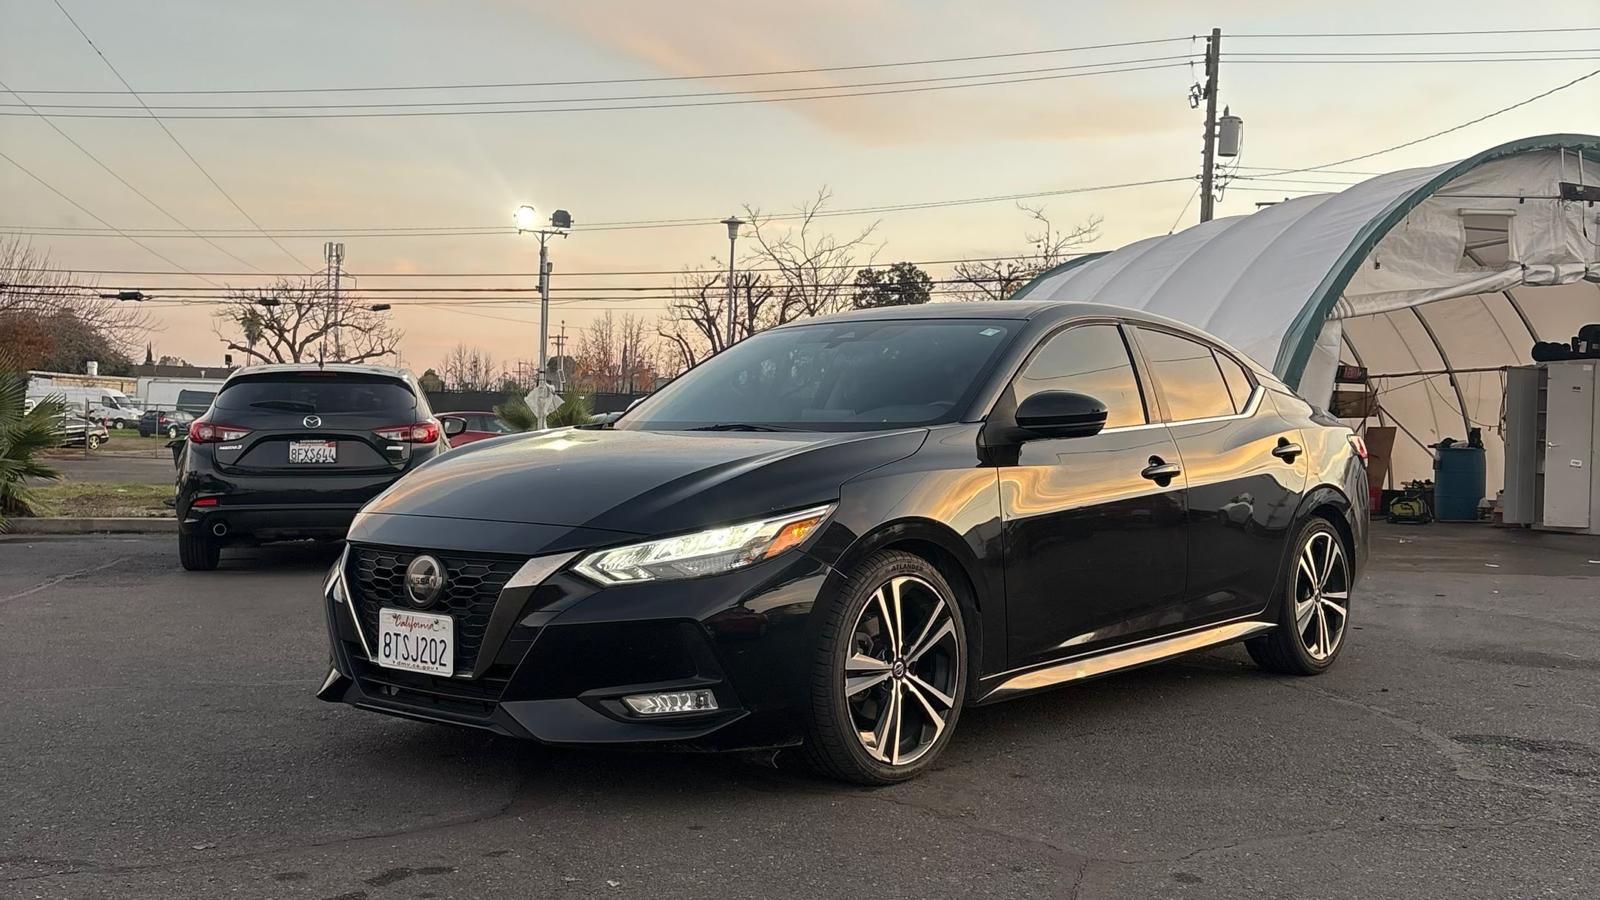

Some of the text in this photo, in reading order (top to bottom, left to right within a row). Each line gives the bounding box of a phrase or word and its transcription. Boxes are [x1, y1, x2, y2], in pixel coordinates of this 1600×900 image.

[291, 448, 334, 460] 8FXS644
[392, 613, 439, 632] California
[383, 631, 447, 667] 8TSJ202
